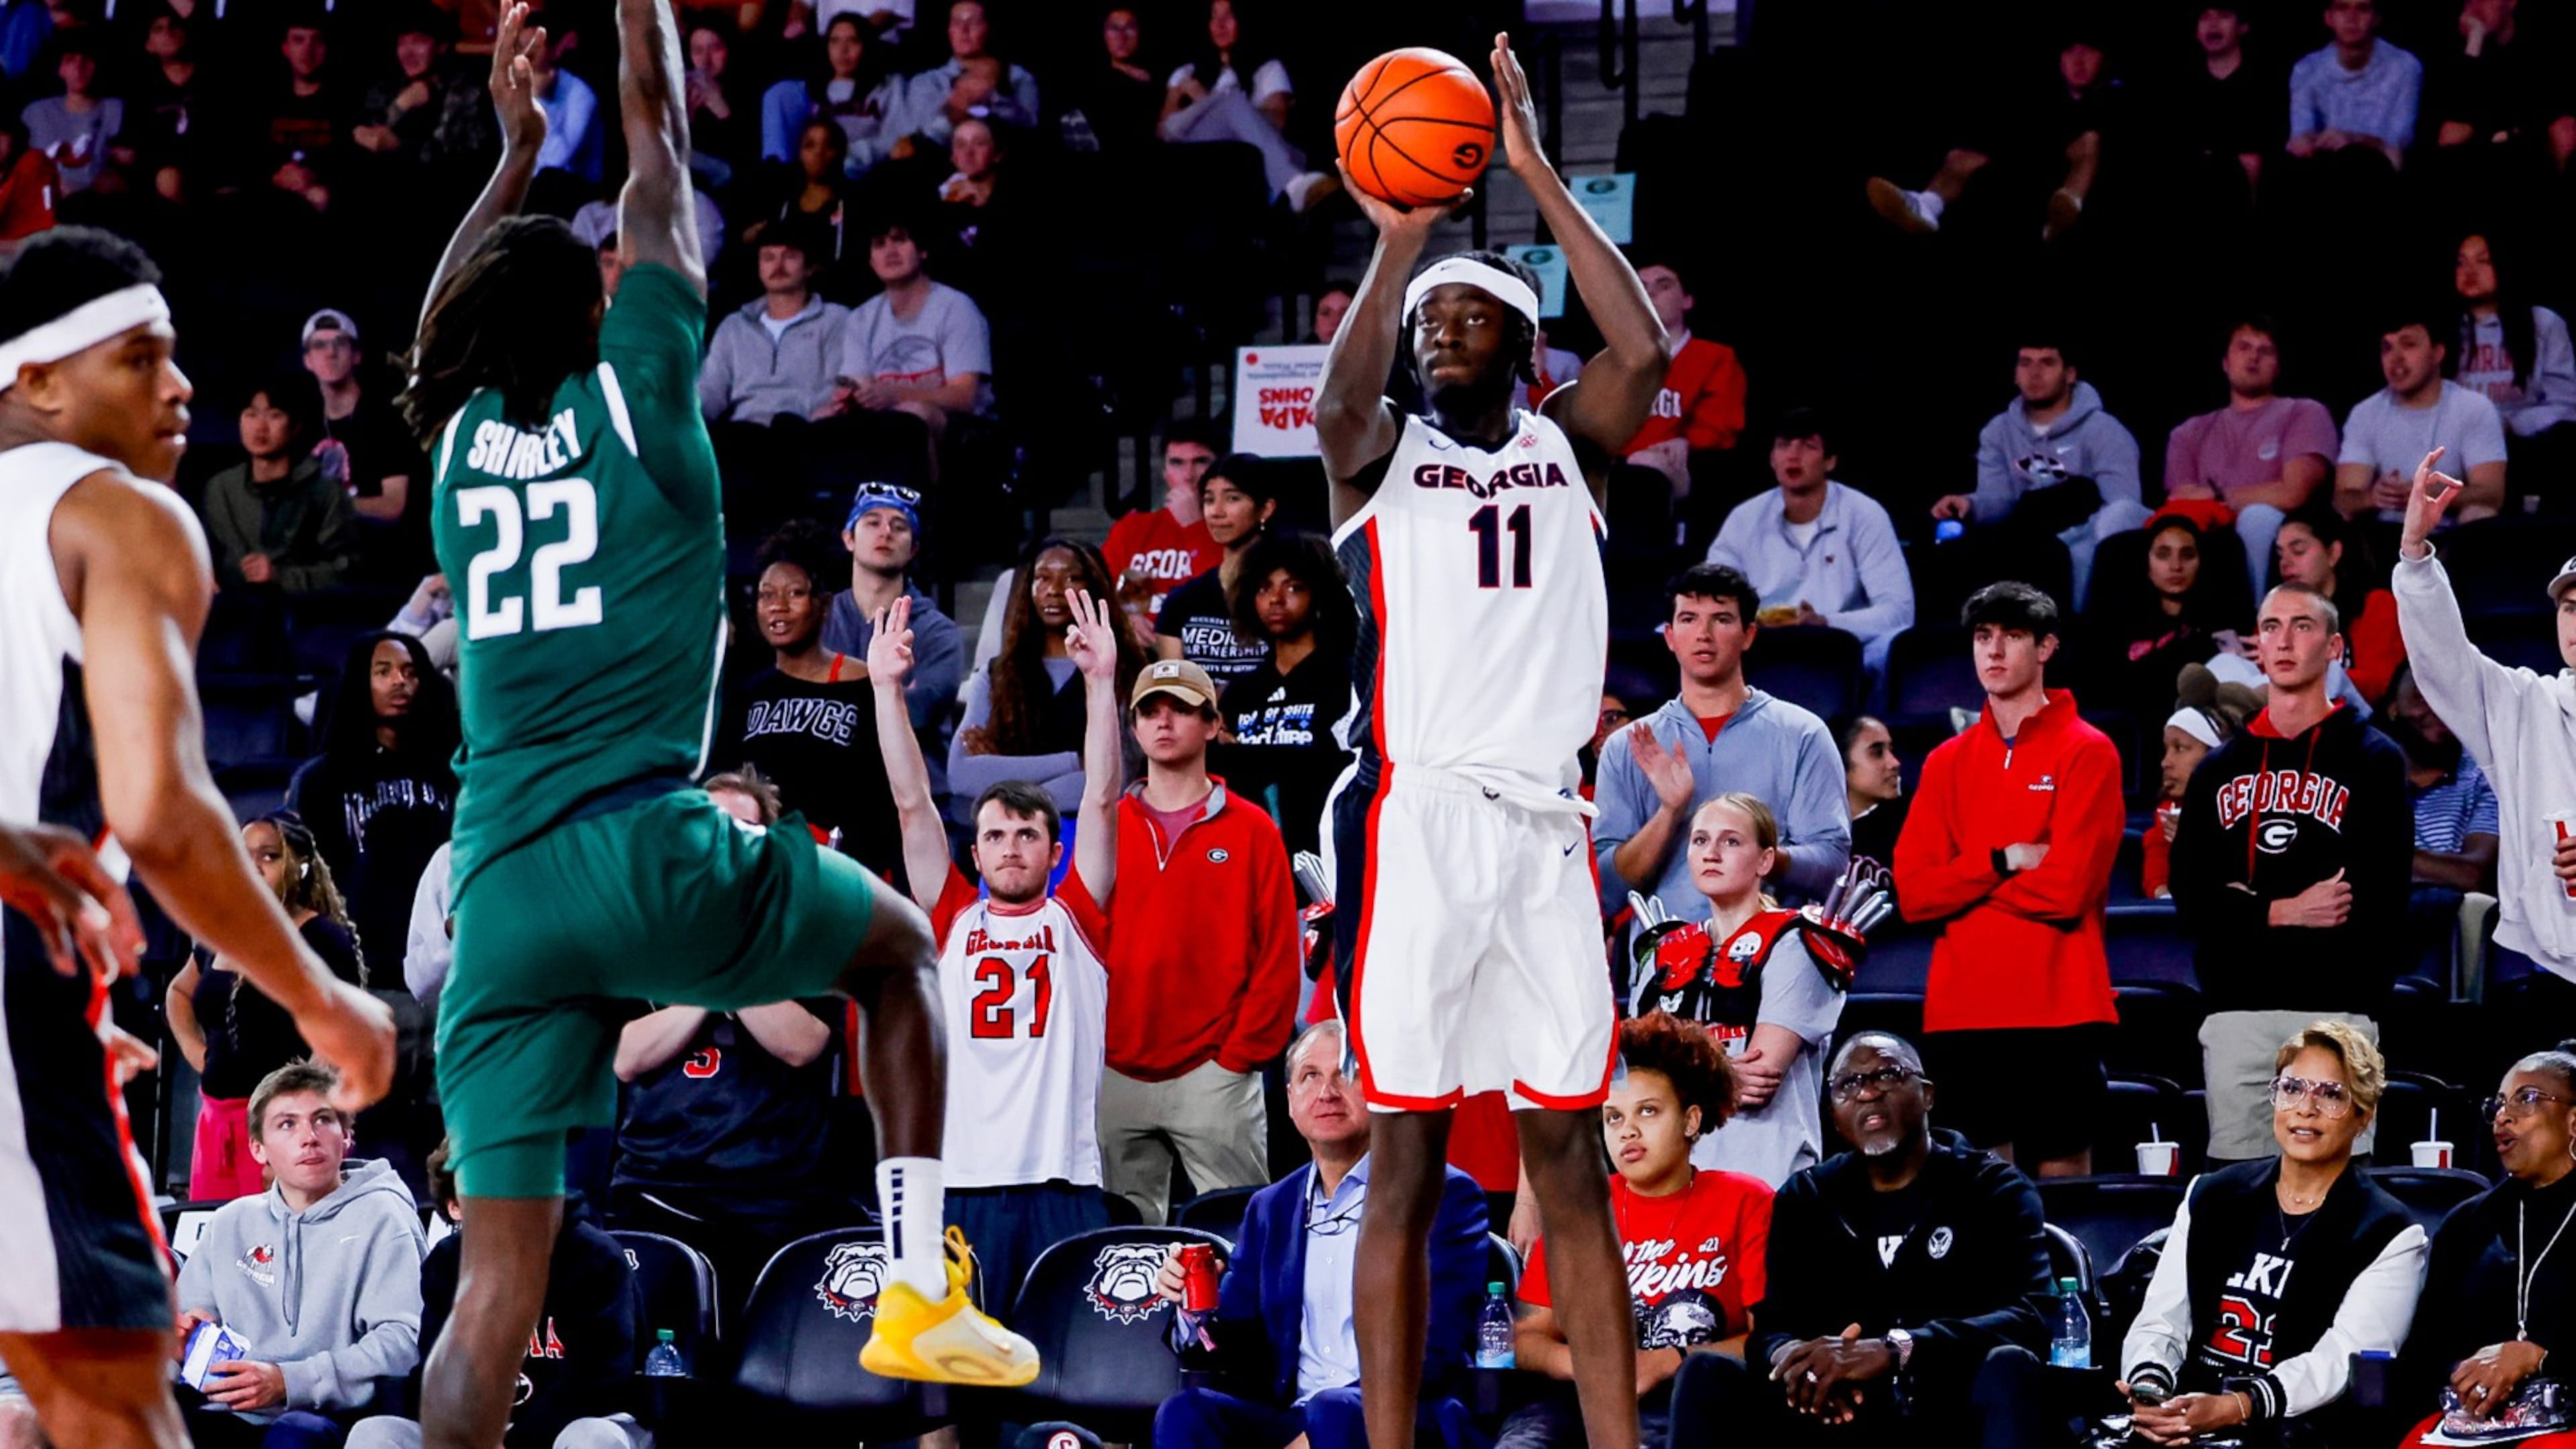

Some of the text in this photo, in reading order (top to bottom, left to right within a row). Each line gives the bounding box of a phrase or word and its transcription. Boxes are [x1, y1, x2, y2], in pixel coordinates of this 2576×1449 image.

[1259, 386, 1314, 404] OHNS
[467, 407, 582, 480] SHIRLEY
[1413, 462, 1570, 500] GEORGIA
[456, 477, 603, 641] 22
[1130, 547, 1193, 580] GEOR
[1468, 503, 1533, 589] 11
[1183, 644, 1270, 658] ARTNERSHIP
[743, 698, 859, 747] DAWGS
[2216, 769, 2350, 835] GEORGIA
[971, 953, 1052, 1038] 21
